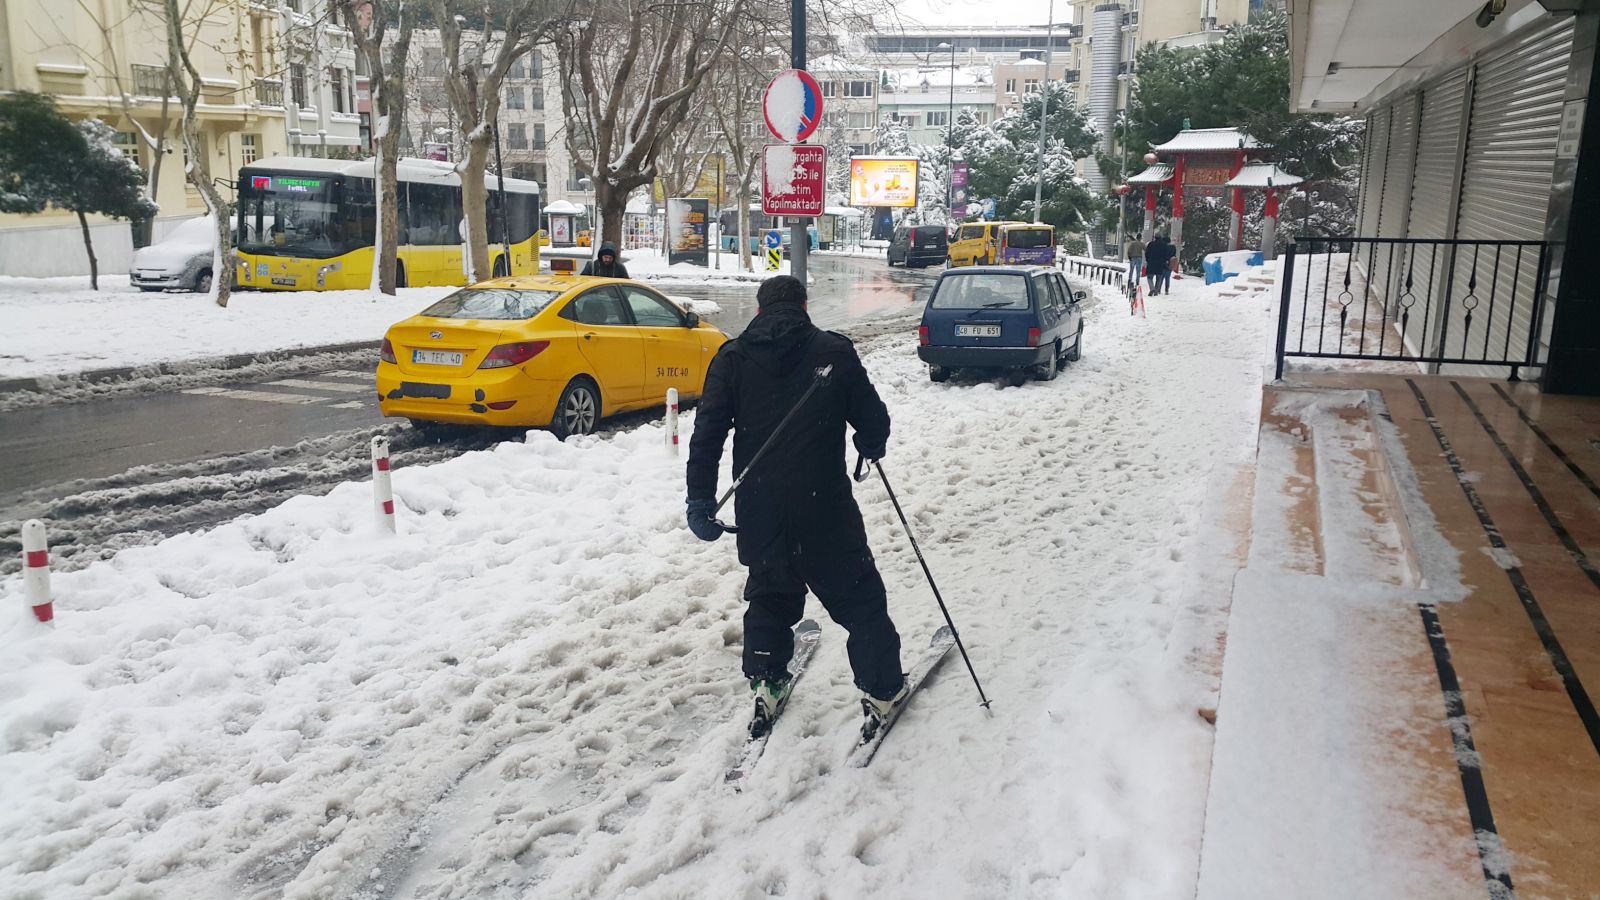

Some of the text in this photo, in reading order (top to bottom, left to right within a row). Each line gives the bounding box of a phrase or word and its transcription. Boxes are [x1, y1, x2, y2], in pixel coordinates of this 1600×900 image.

[809, 168, 819, 180] ile
[765, 195, 821, 212] Yapılmaktadır
[960, 327, 968, 335] 48
[987, 327, 999, 335] 651
[417, 351, 461, 364] 34 TEC 40
[667, 367, 679, 377] TEC
[680, 367, 689, 377] 40
